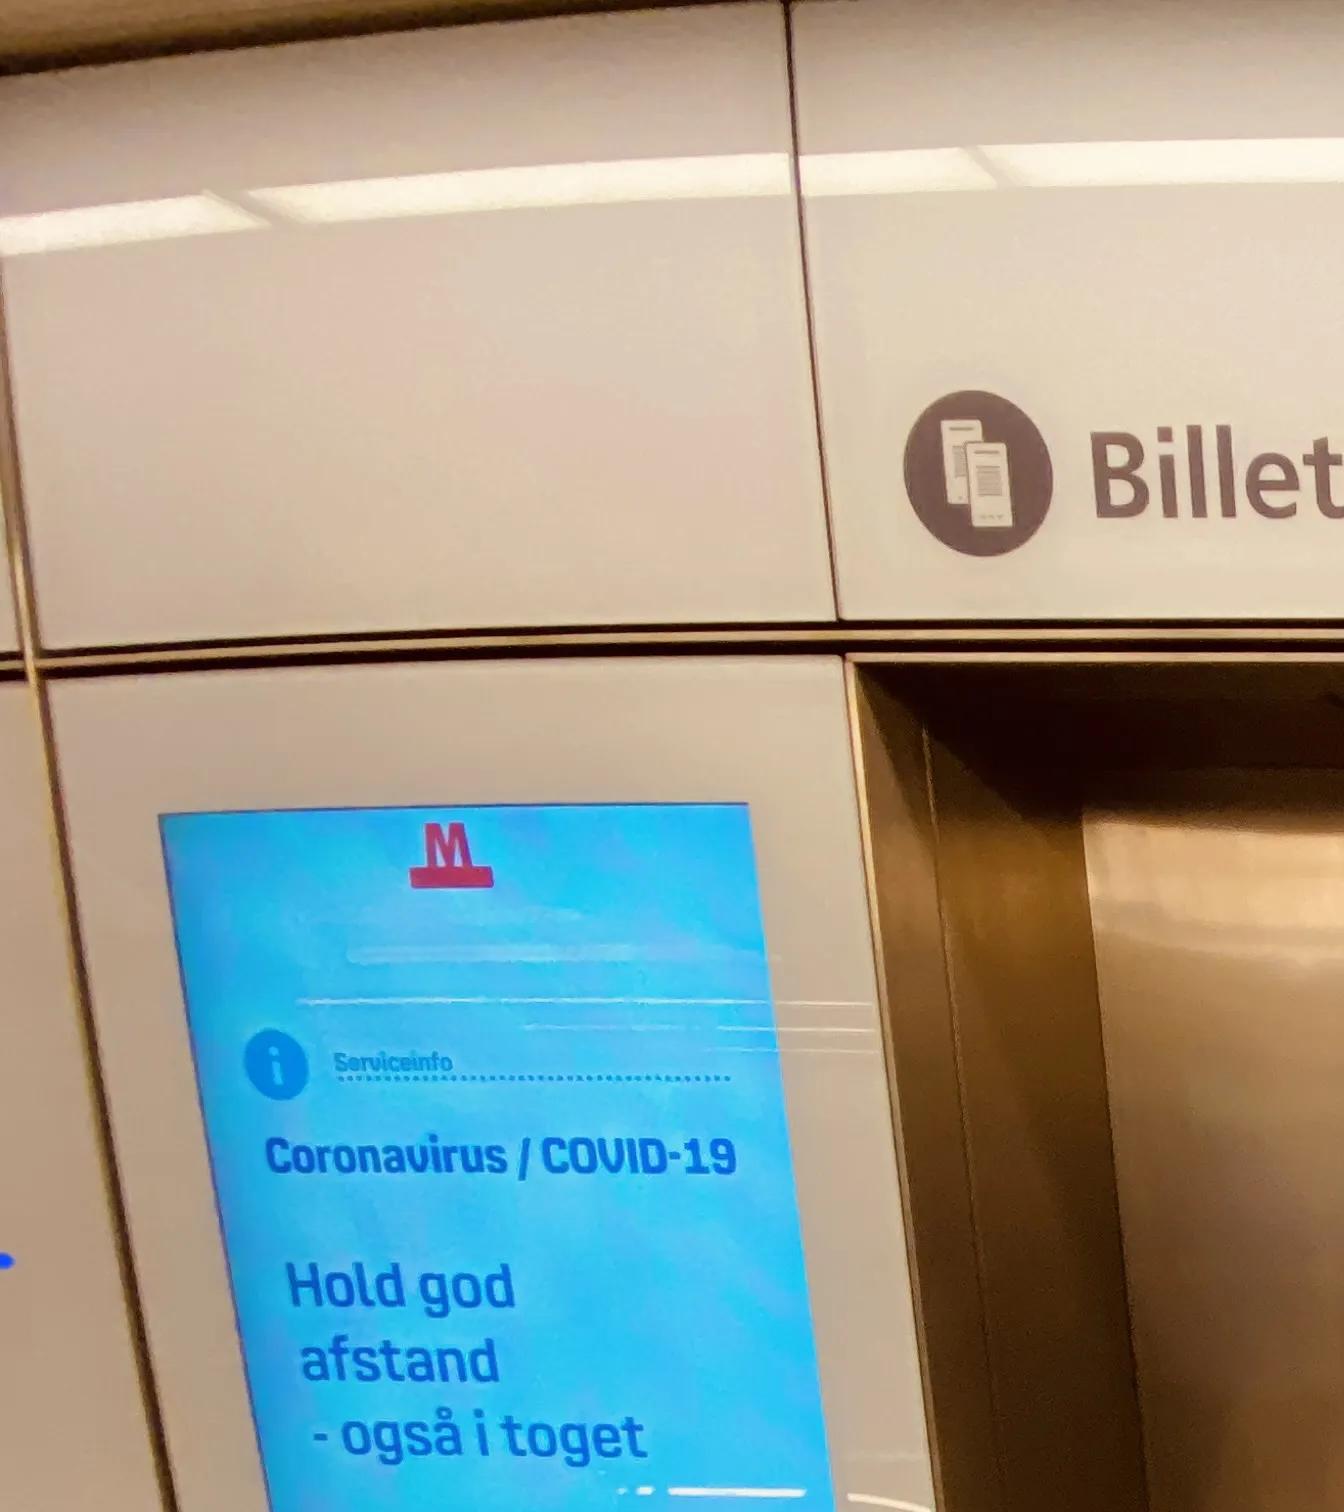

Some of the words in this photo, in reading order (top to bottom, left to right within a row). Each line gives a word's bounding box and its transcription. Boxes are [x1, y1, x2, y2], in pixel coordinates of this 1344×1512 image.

[333, 1050, 454, 1073] Serviceinfo
[264, 1133, 508, 1175] Coronavirus
[541, 1136, 737, 1176] COVID-19
[284, 1261, 406, 1308] Hold
[418, 1262, 516, 1319] god
[299, 1334, 500, 1383] afstand
[340, 1406, 464, 1467] også
[473, 1408, 490, 1457] i
[499, 1415, 648, 1468] toget
